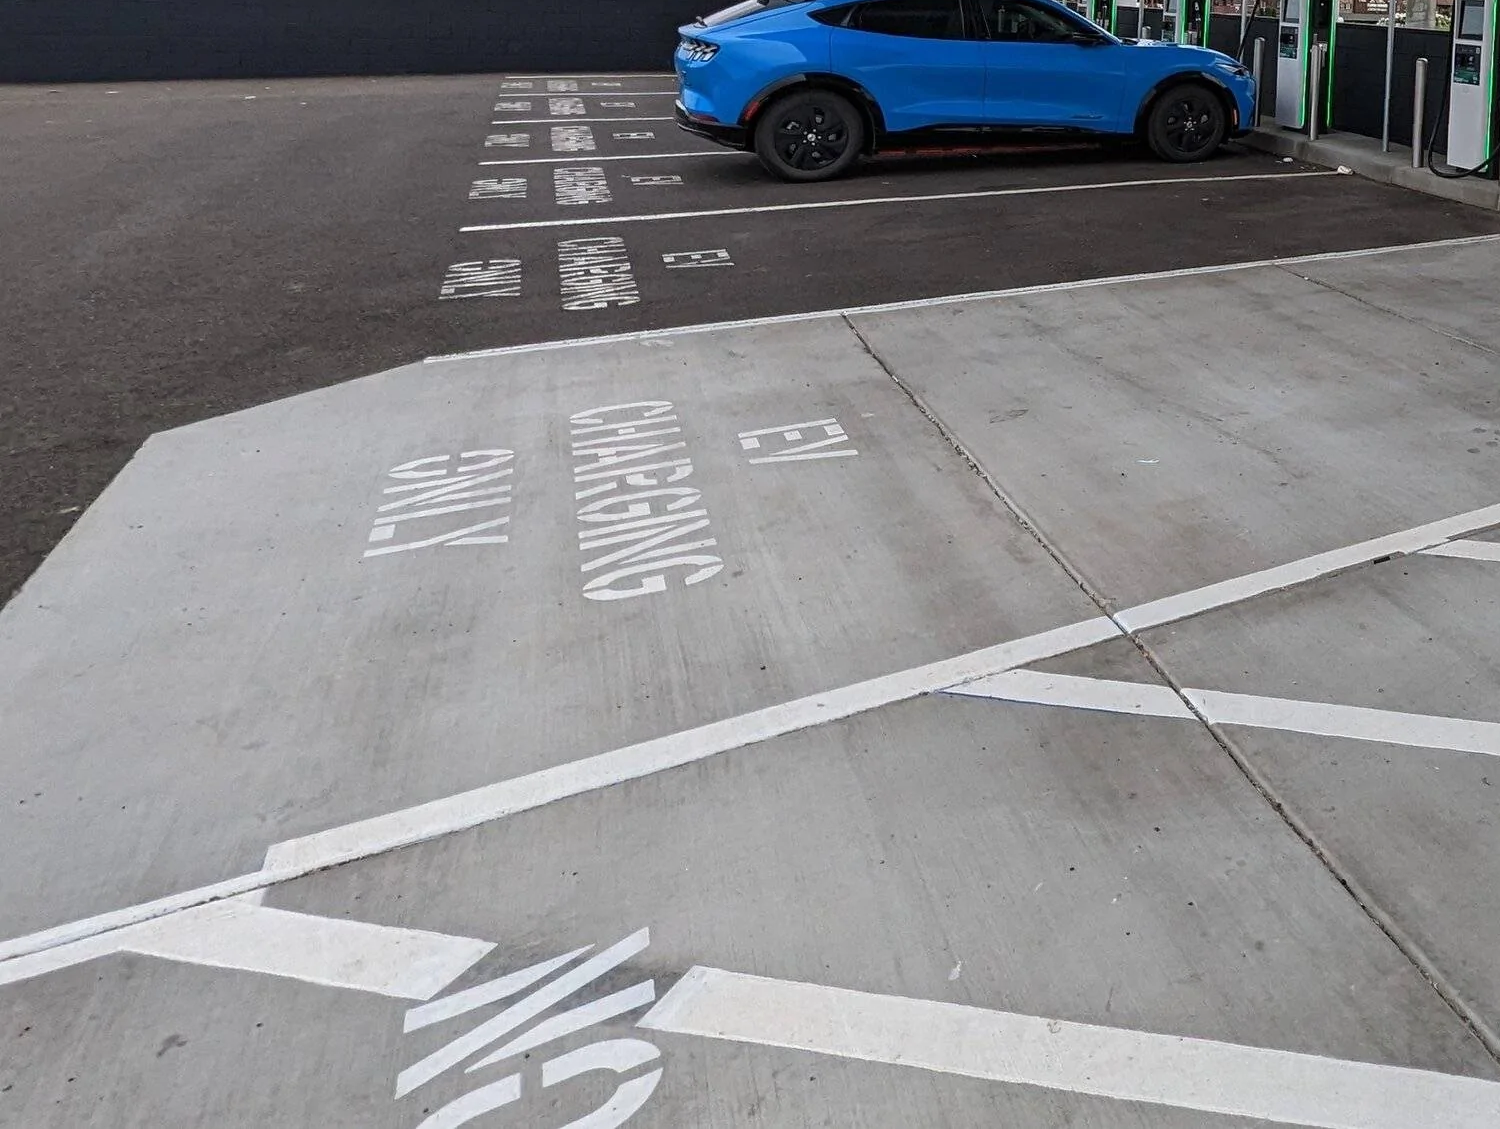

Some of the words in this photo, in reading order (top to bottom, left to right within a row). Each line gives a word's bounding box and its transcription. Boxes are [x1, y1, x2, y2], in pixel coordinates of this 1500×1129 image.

[438, 259, 522, 300] ONLY
[557, 236, 641, 311] CHARGING
[661, 248, 735, 269] EV
[738, 417, 859, 464] EV
[363, 448, 515, 558] ONLY
[569, 400, 725, 601] CHARGING
